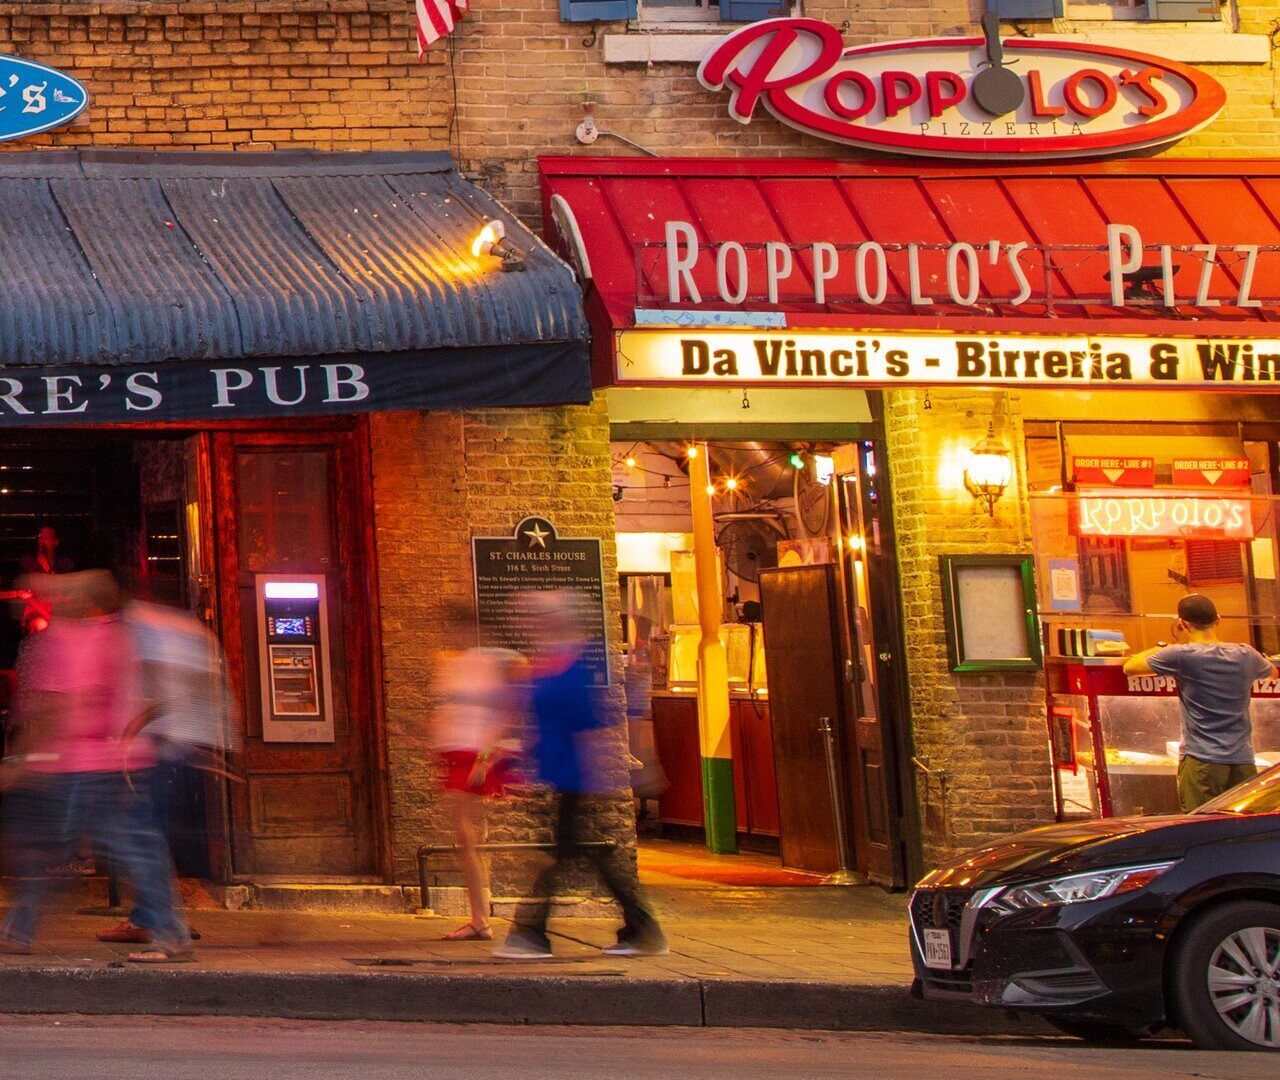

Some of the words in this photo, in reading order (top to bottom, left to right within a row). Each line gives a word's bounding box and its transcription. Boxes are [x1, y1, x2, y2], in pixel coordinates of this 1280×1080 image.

[920, 120, 1086, 136] PIZZERIA
[664, 220, 1034, 307] ROPPOLO'S
[1105, 223, 1263, 309] PIZZ
[680, 339, 739, 377] Da
[753, 338, 911, 377] Vinci's
[955, 340, 1132, 380] Birreria
[1148, 343, 1181, 381] &
[1195, 344, 1280, 381] Win
[209, 362, 371, 409] PUB
[1074, 458, 1100, 469] ORDER
[1174, 460, 1198, 471] ORDER
[489, 552, 504, 561] ST.
[506, 552, 551, 561] CHARLES
[553, 552, 586, 561] HOUSE
[551, 564, 571, 572] Street
